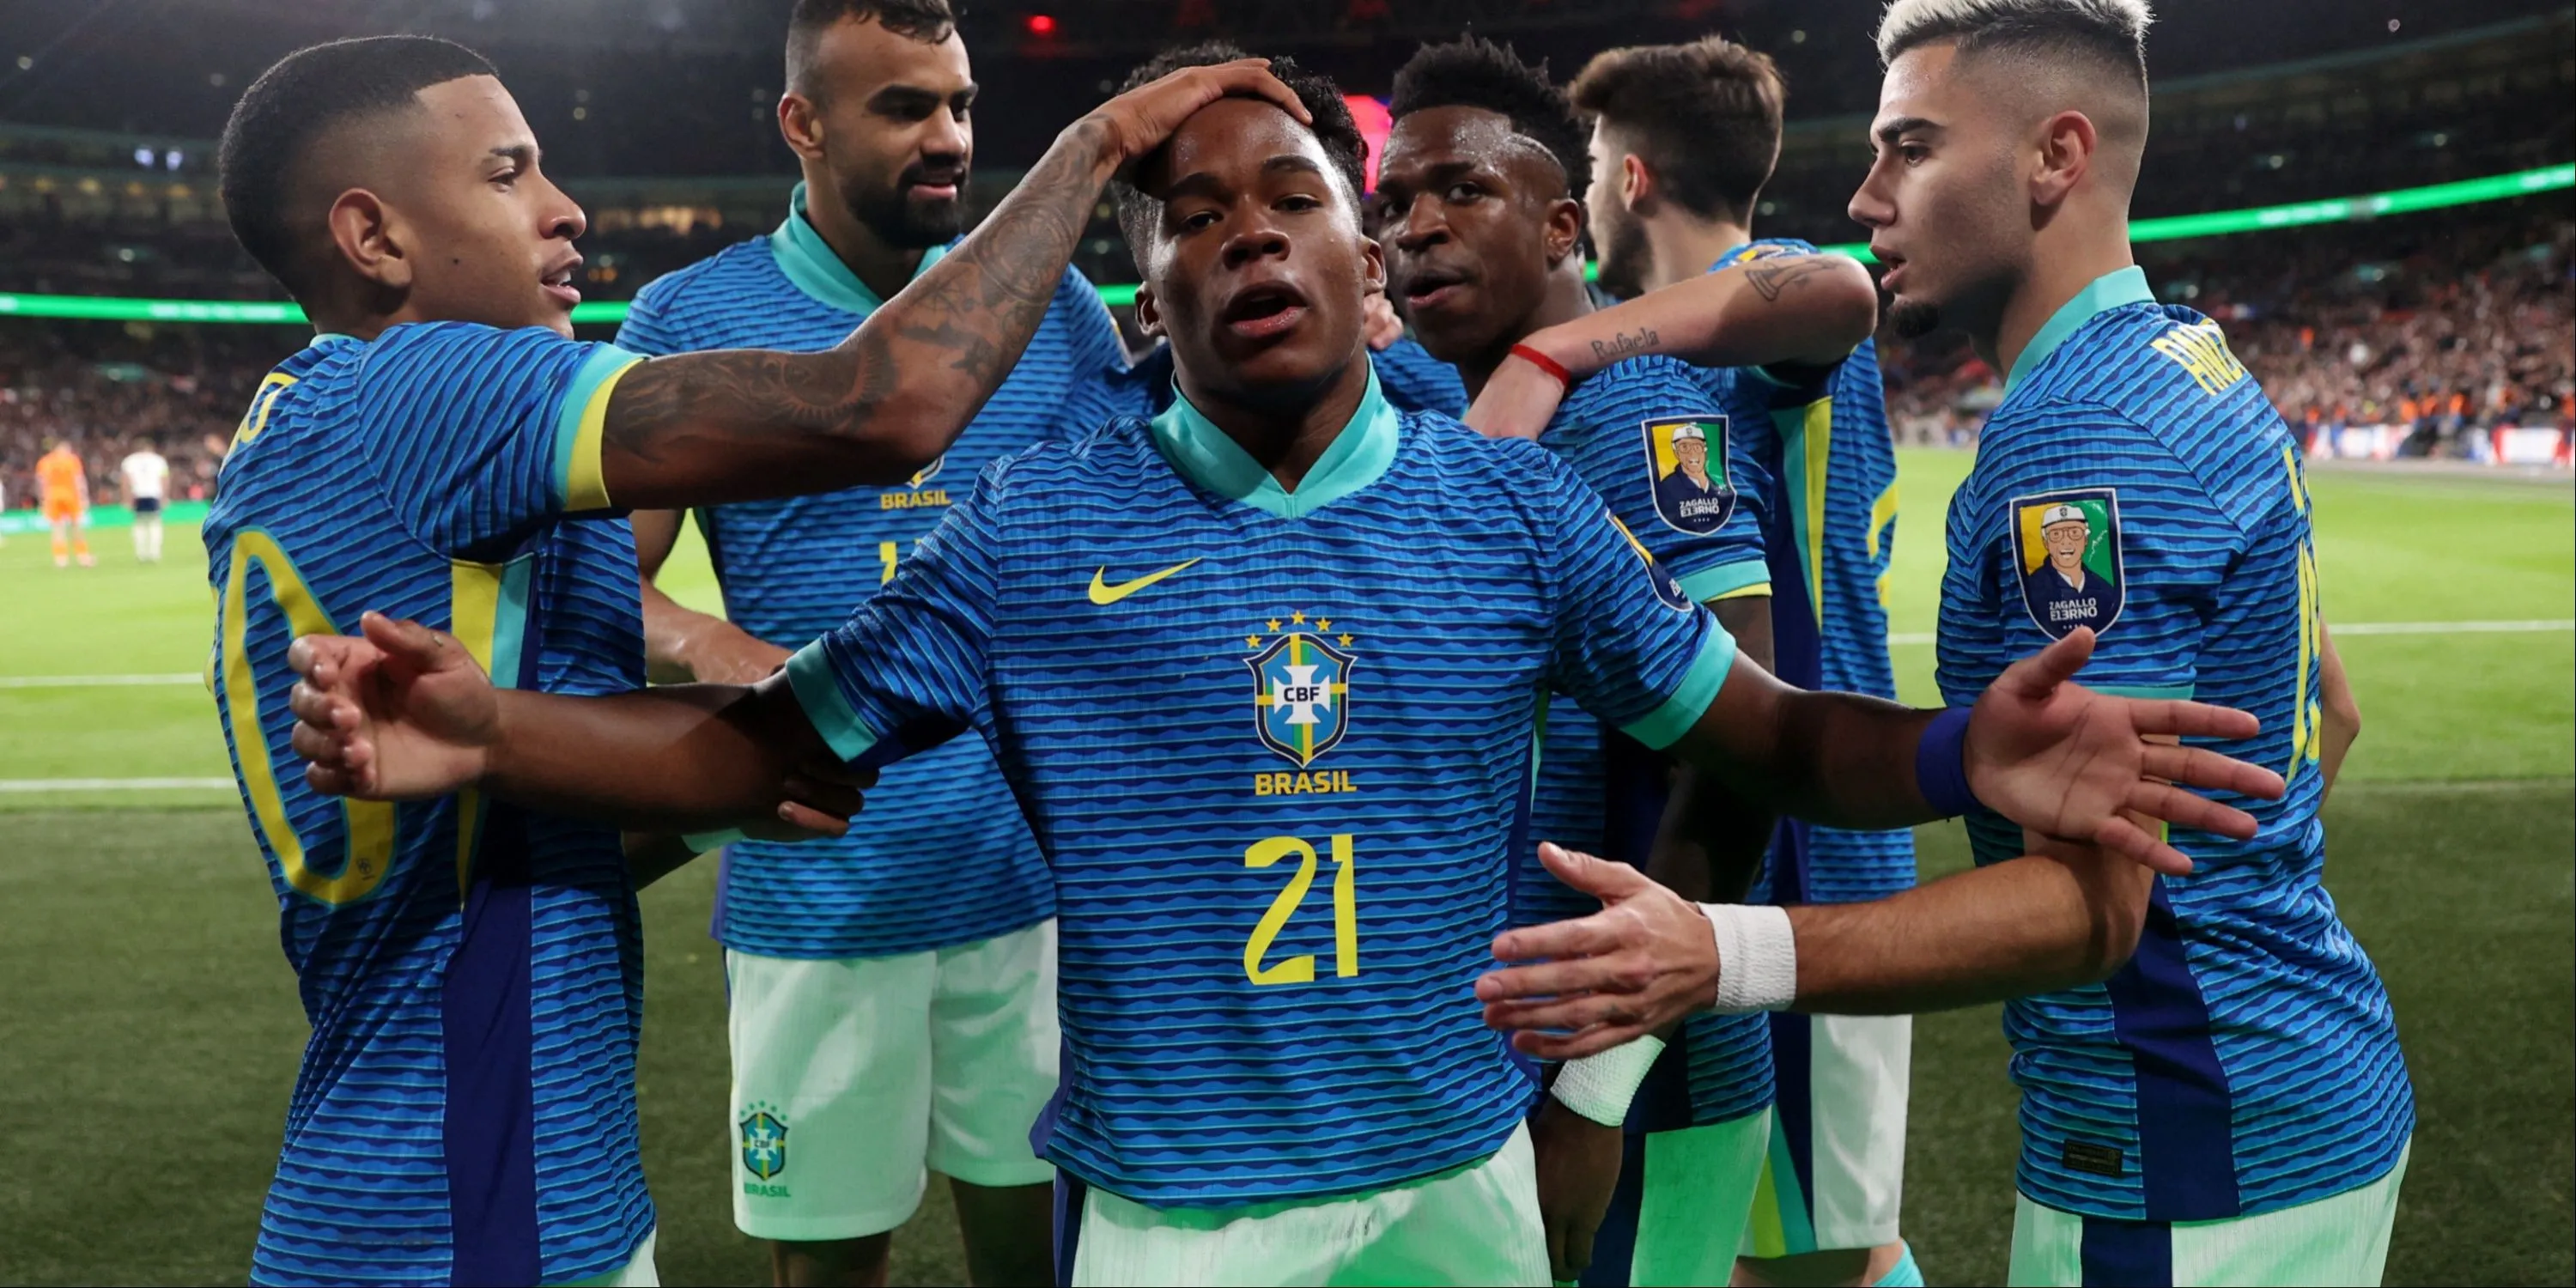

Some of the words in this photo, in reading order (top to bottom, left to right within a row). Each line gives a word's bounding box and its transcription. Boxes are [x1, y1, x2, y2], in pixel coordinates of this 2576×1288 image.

[1591, 327, 1661, 360] Rafaela
[880, 489, 952, 509] BRASIL
[1680, 497, 1718, 509] ZAGALLO
[2049, 598, 2096, 611] ZAGALLO
[1284, 686, 1321, 703] CBF
[204, 526, 398, 907] 0
[1255, 770, 1358, 796] BRASIL
[1243, 834, 1358, 986] 21
[744, 1182, 792, 1198] BRASIL
